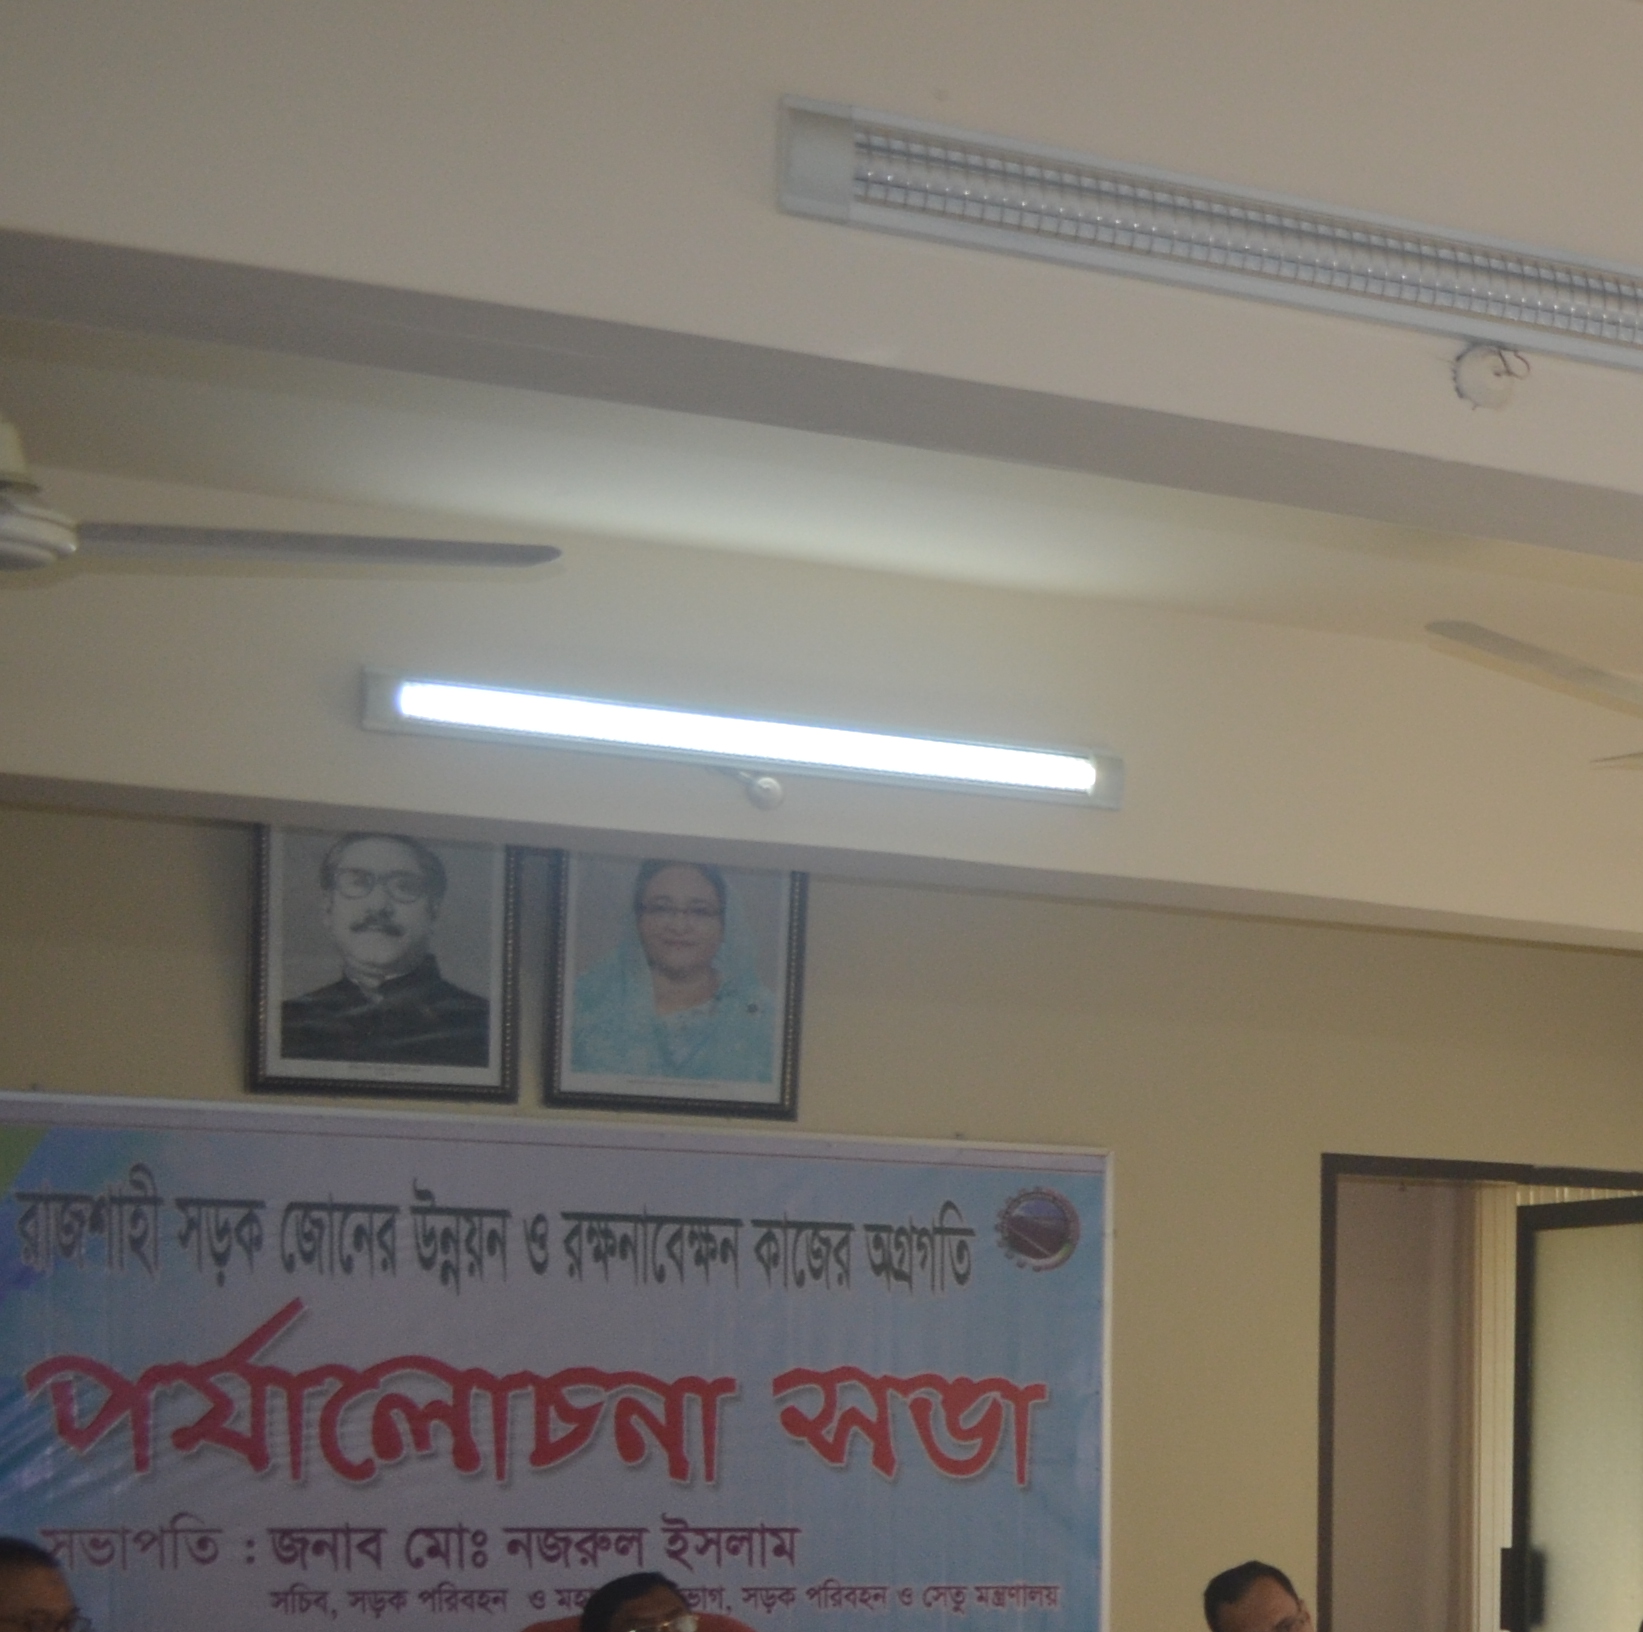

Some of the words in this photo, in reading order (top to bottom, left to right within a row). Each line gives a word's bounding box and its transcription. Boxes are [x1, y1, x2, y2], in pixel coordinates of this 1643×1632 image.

[14, 1162, 163, 1279] রাজশাহী
[175, 1197, 267, 1287] সড়ক
[280, 1192, 400, 1280] জোনের
[409, 1177, 511, 1297] উন্নয়ন
[523, 1212, 550, 1276] ও
[751, 1210, 855, 1292] কাজের
[863, 1200, 977, 1298] অগ্রগতি
[24, 1297, 736, 1483] পর্যালোচনা
[772, 1366, 1048, 1486] সভা
[39, 1511, 223, 1571] সভাপতি
[266, 1521, 388, 1573] জনাব
[405, 1522, 489, 1571] মোঃ
[504, 1526, 650, 1570] নজরুল
[661, 1511, 802, 1572] ইসলাম
[269, 1582, 338, 1620] সচিব,
[347, 1588, 408, 1620] সড়ক
[418, 1581, 509, 1617] পরিবহন
[528, 1590, 546, 1611] ও
[741, 1587, 797, 1615] সড়ক
[805, 1577, 888, 1612] পরিবহন
[898, 1587, 915, 1609] ও
[922, 1584, 968, 1617] সেতু
